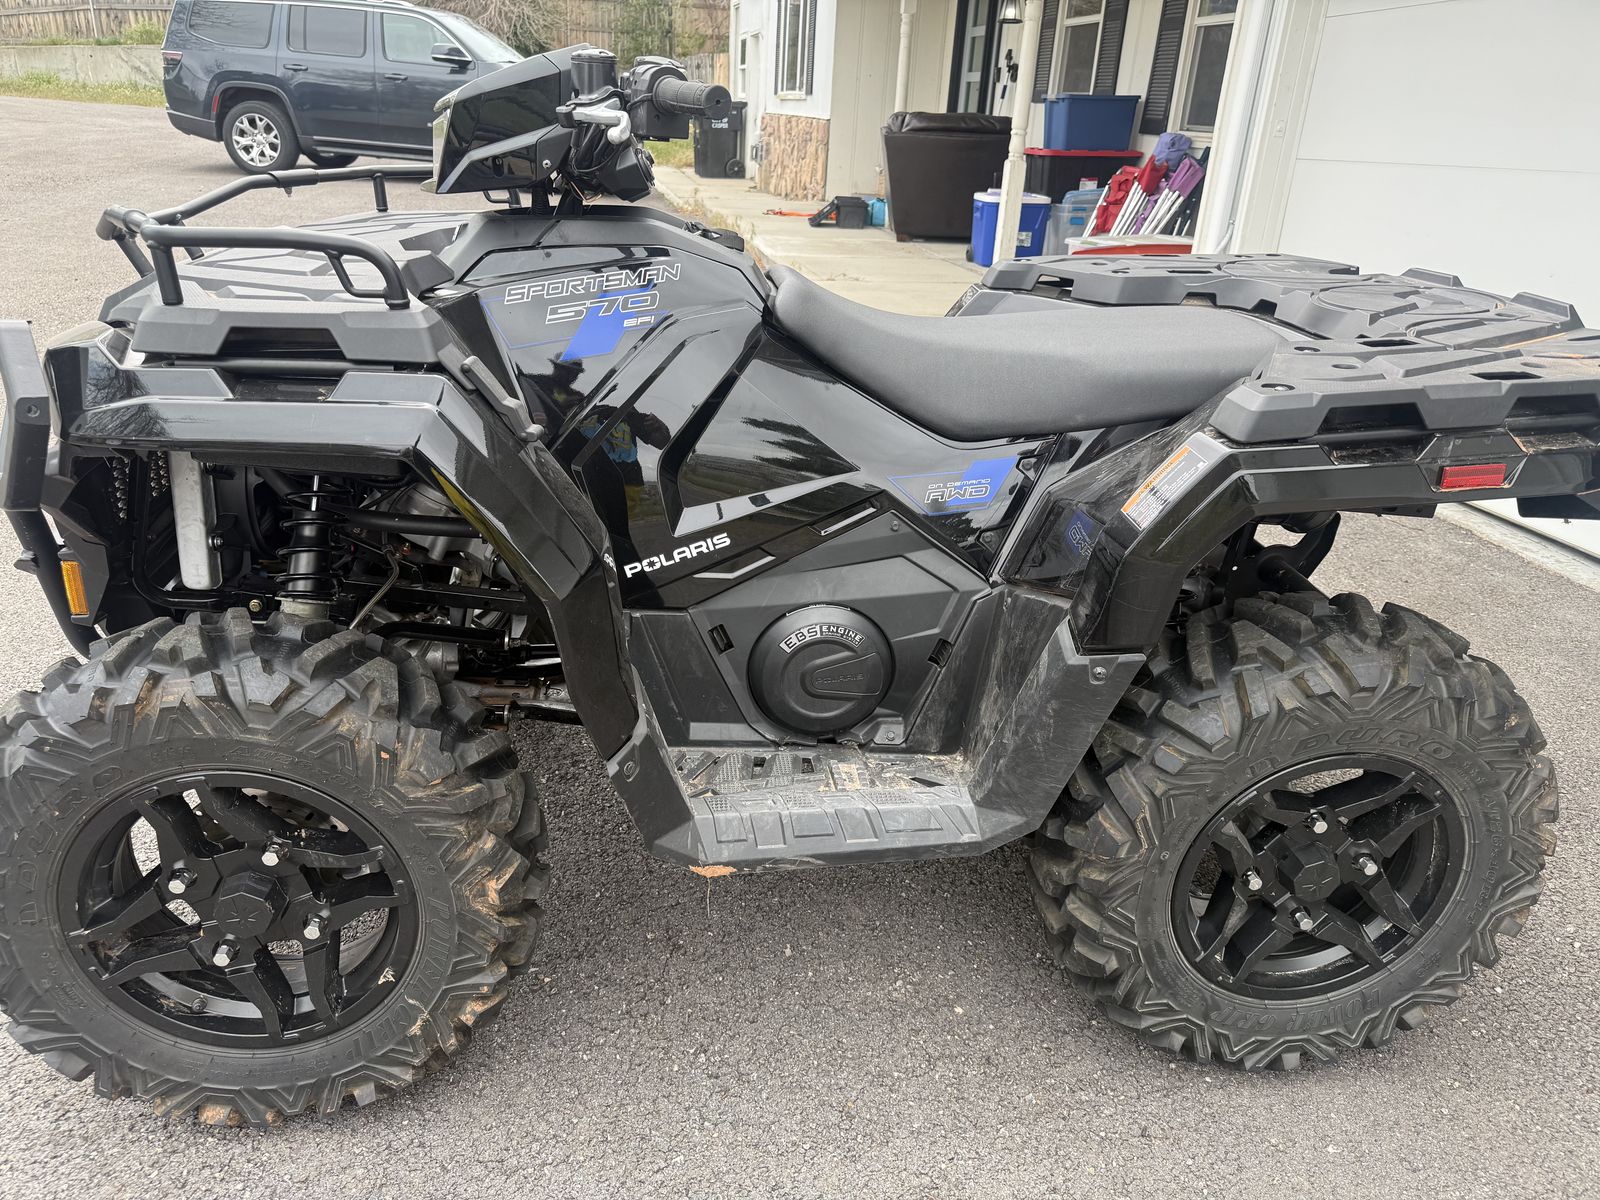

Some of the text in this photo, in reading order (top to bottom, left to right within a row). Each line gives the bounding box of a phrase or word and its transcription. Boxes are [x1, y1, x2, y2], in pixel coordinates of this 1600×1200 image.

[504, 263, 681, 304] SPORTSMAN
[545, 291, 659, 324] 570
[623, 316, 655, 327] EFI
[924, 484, 991, 503] AWD
[946, 478, 991, 488] DEMAND
[623, 532, 731, 579] POLARIS
[784, 625, 863, 650] EBS ENGINE
